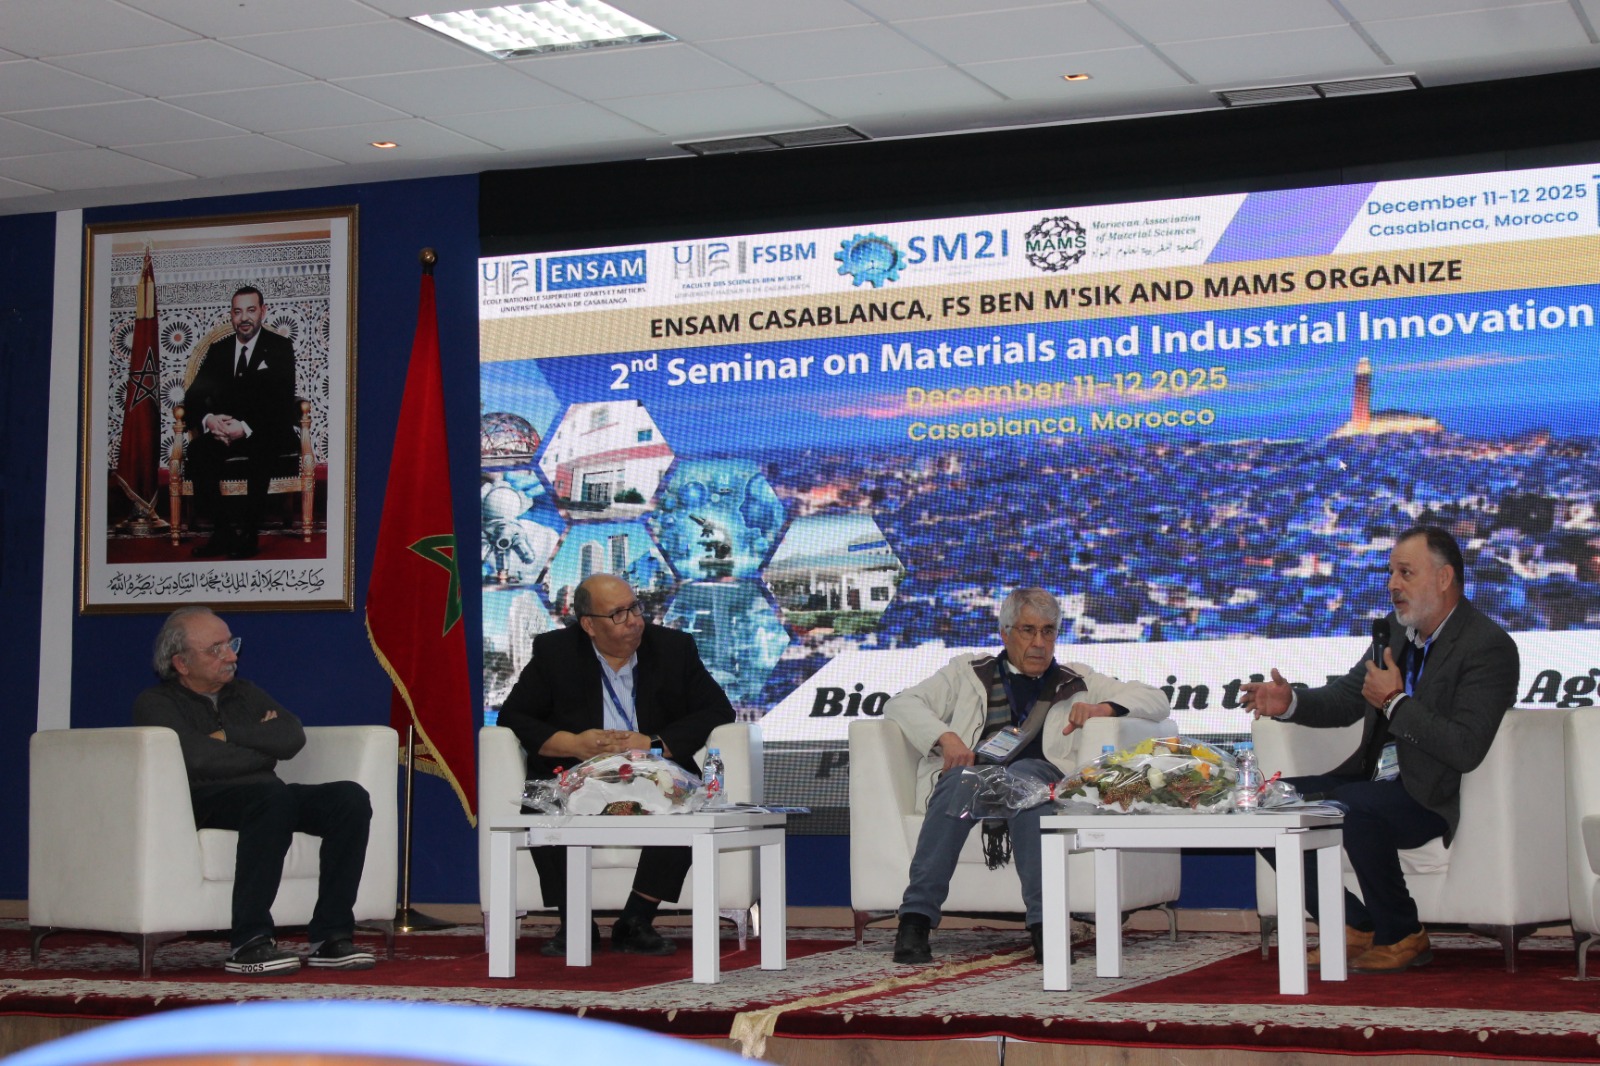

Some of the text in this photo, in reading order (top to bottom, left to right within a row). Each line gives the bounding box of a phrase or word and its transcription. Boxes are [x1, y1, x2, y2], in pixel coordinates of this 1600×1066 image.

[1368, 194, 1477, 215] December
[1535, 183, 1587, 201] 2025
[1092, 214, 1201, 230] Moroccan Association
[1096, 226, 1196, 243] of Material Sciences
[1369, 210, 1579, 237] Casablanca, Morocco
[752, 241, 817, 264] FSBM
[1025, 235, 1087, 253] MAMS
[551, 257, 644, 283] ENSAM
[650, 259, 1462, 338] ENSAM CASABLANCA, FS BEN M'SIK AND MAMS ORGANIZE
[610, 299, 1594, 390] 2nd Seminar on Materials and Industrial Innovation
[907, 380, 1065, 407] December
[1151, 366, 1230, 393] 2025
[907, 408, 1216, 442] Casablanca, Morocco
[1520, 667, 1600, 709] Ag
[241, 962, 264, 972] crocs
